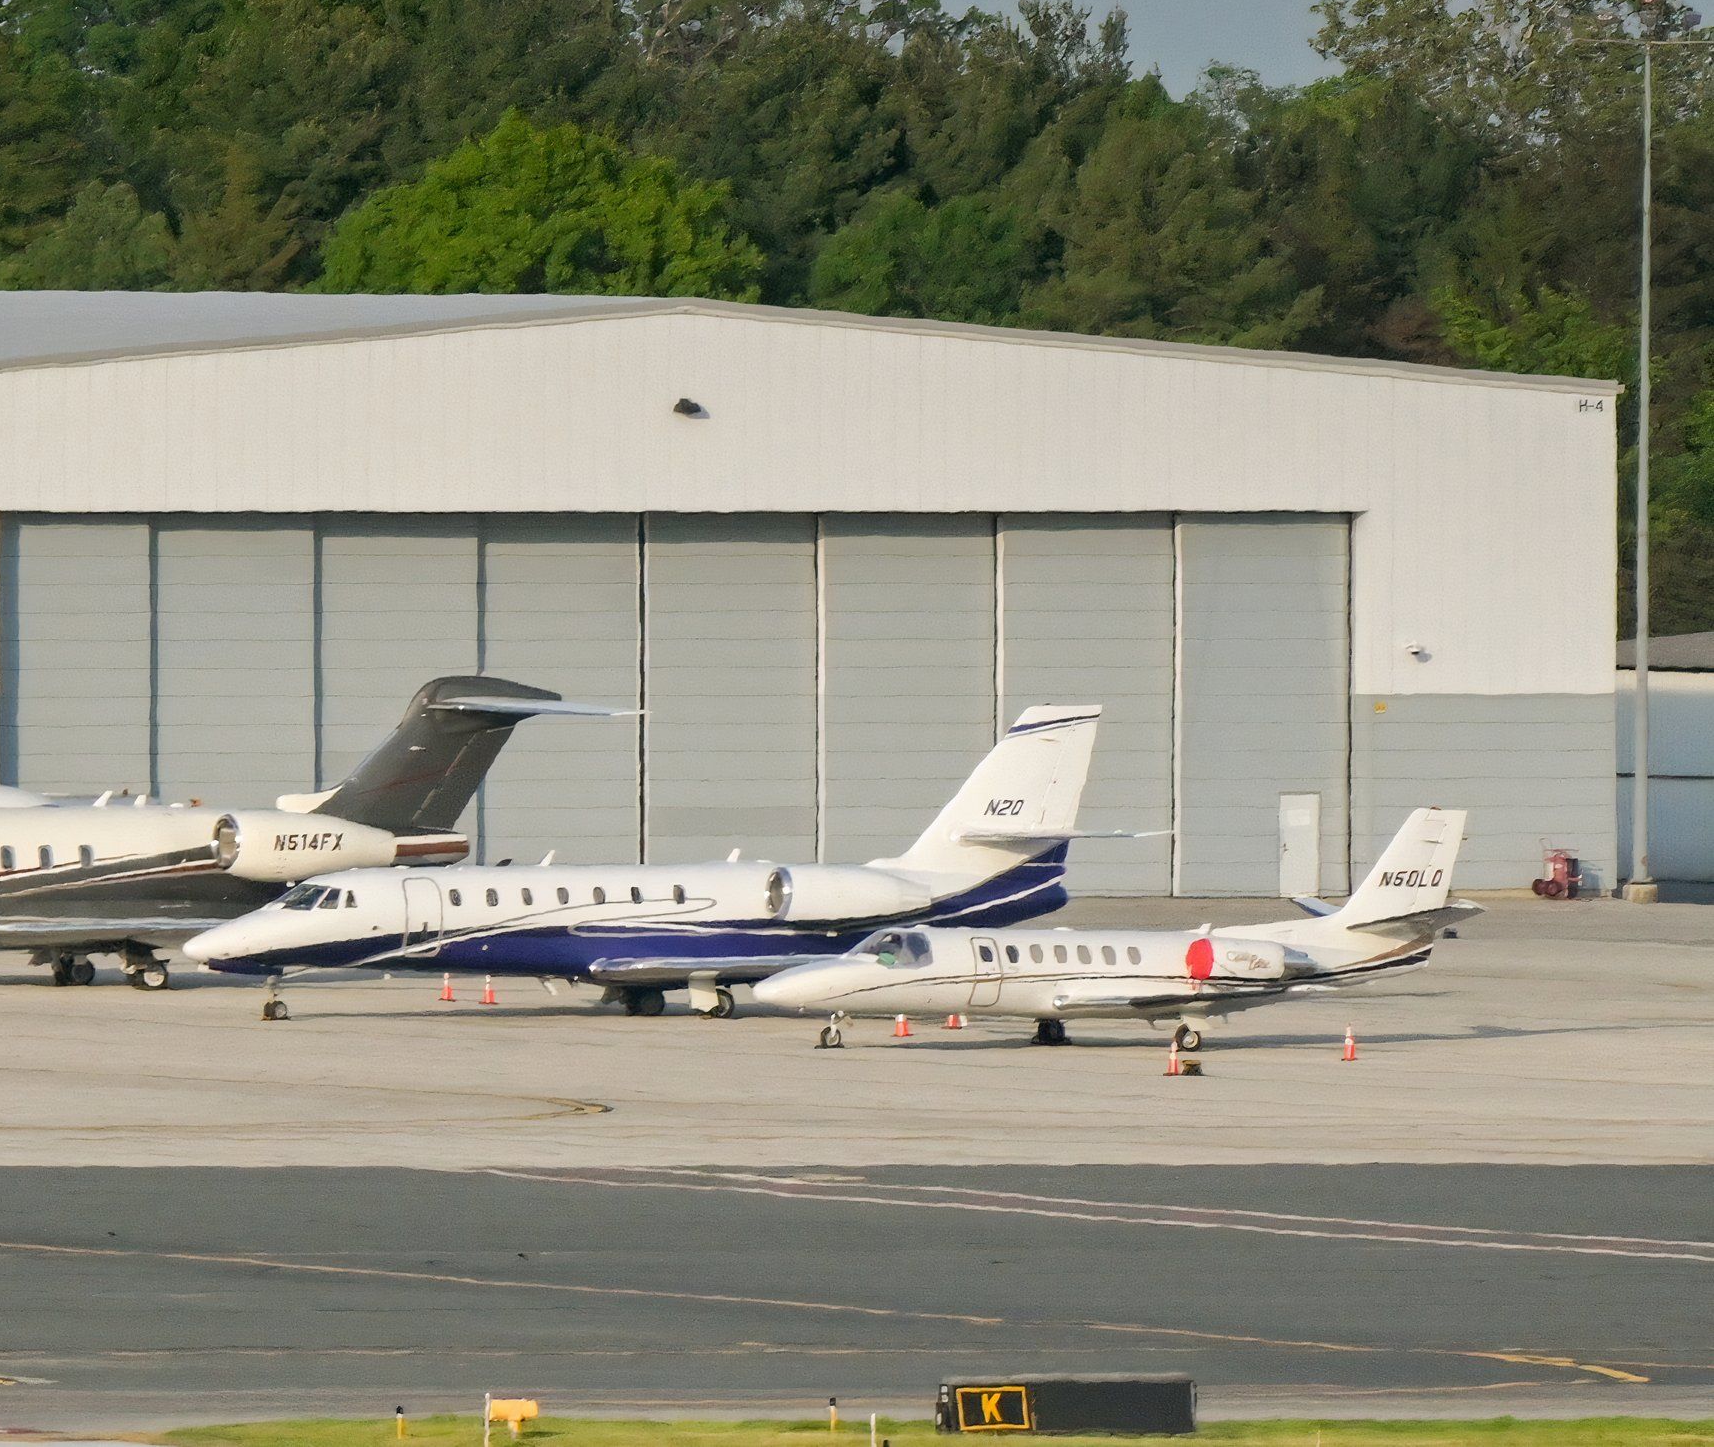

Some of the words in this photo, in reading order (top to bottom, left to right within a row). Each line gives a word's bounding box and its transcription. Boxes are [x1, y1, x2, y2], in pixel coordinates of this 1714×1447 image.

[1578, 399, 1604, 413] H-4
[273, 833, 344, 852] N514FX
[981, 1393, 1003, 1424] K
